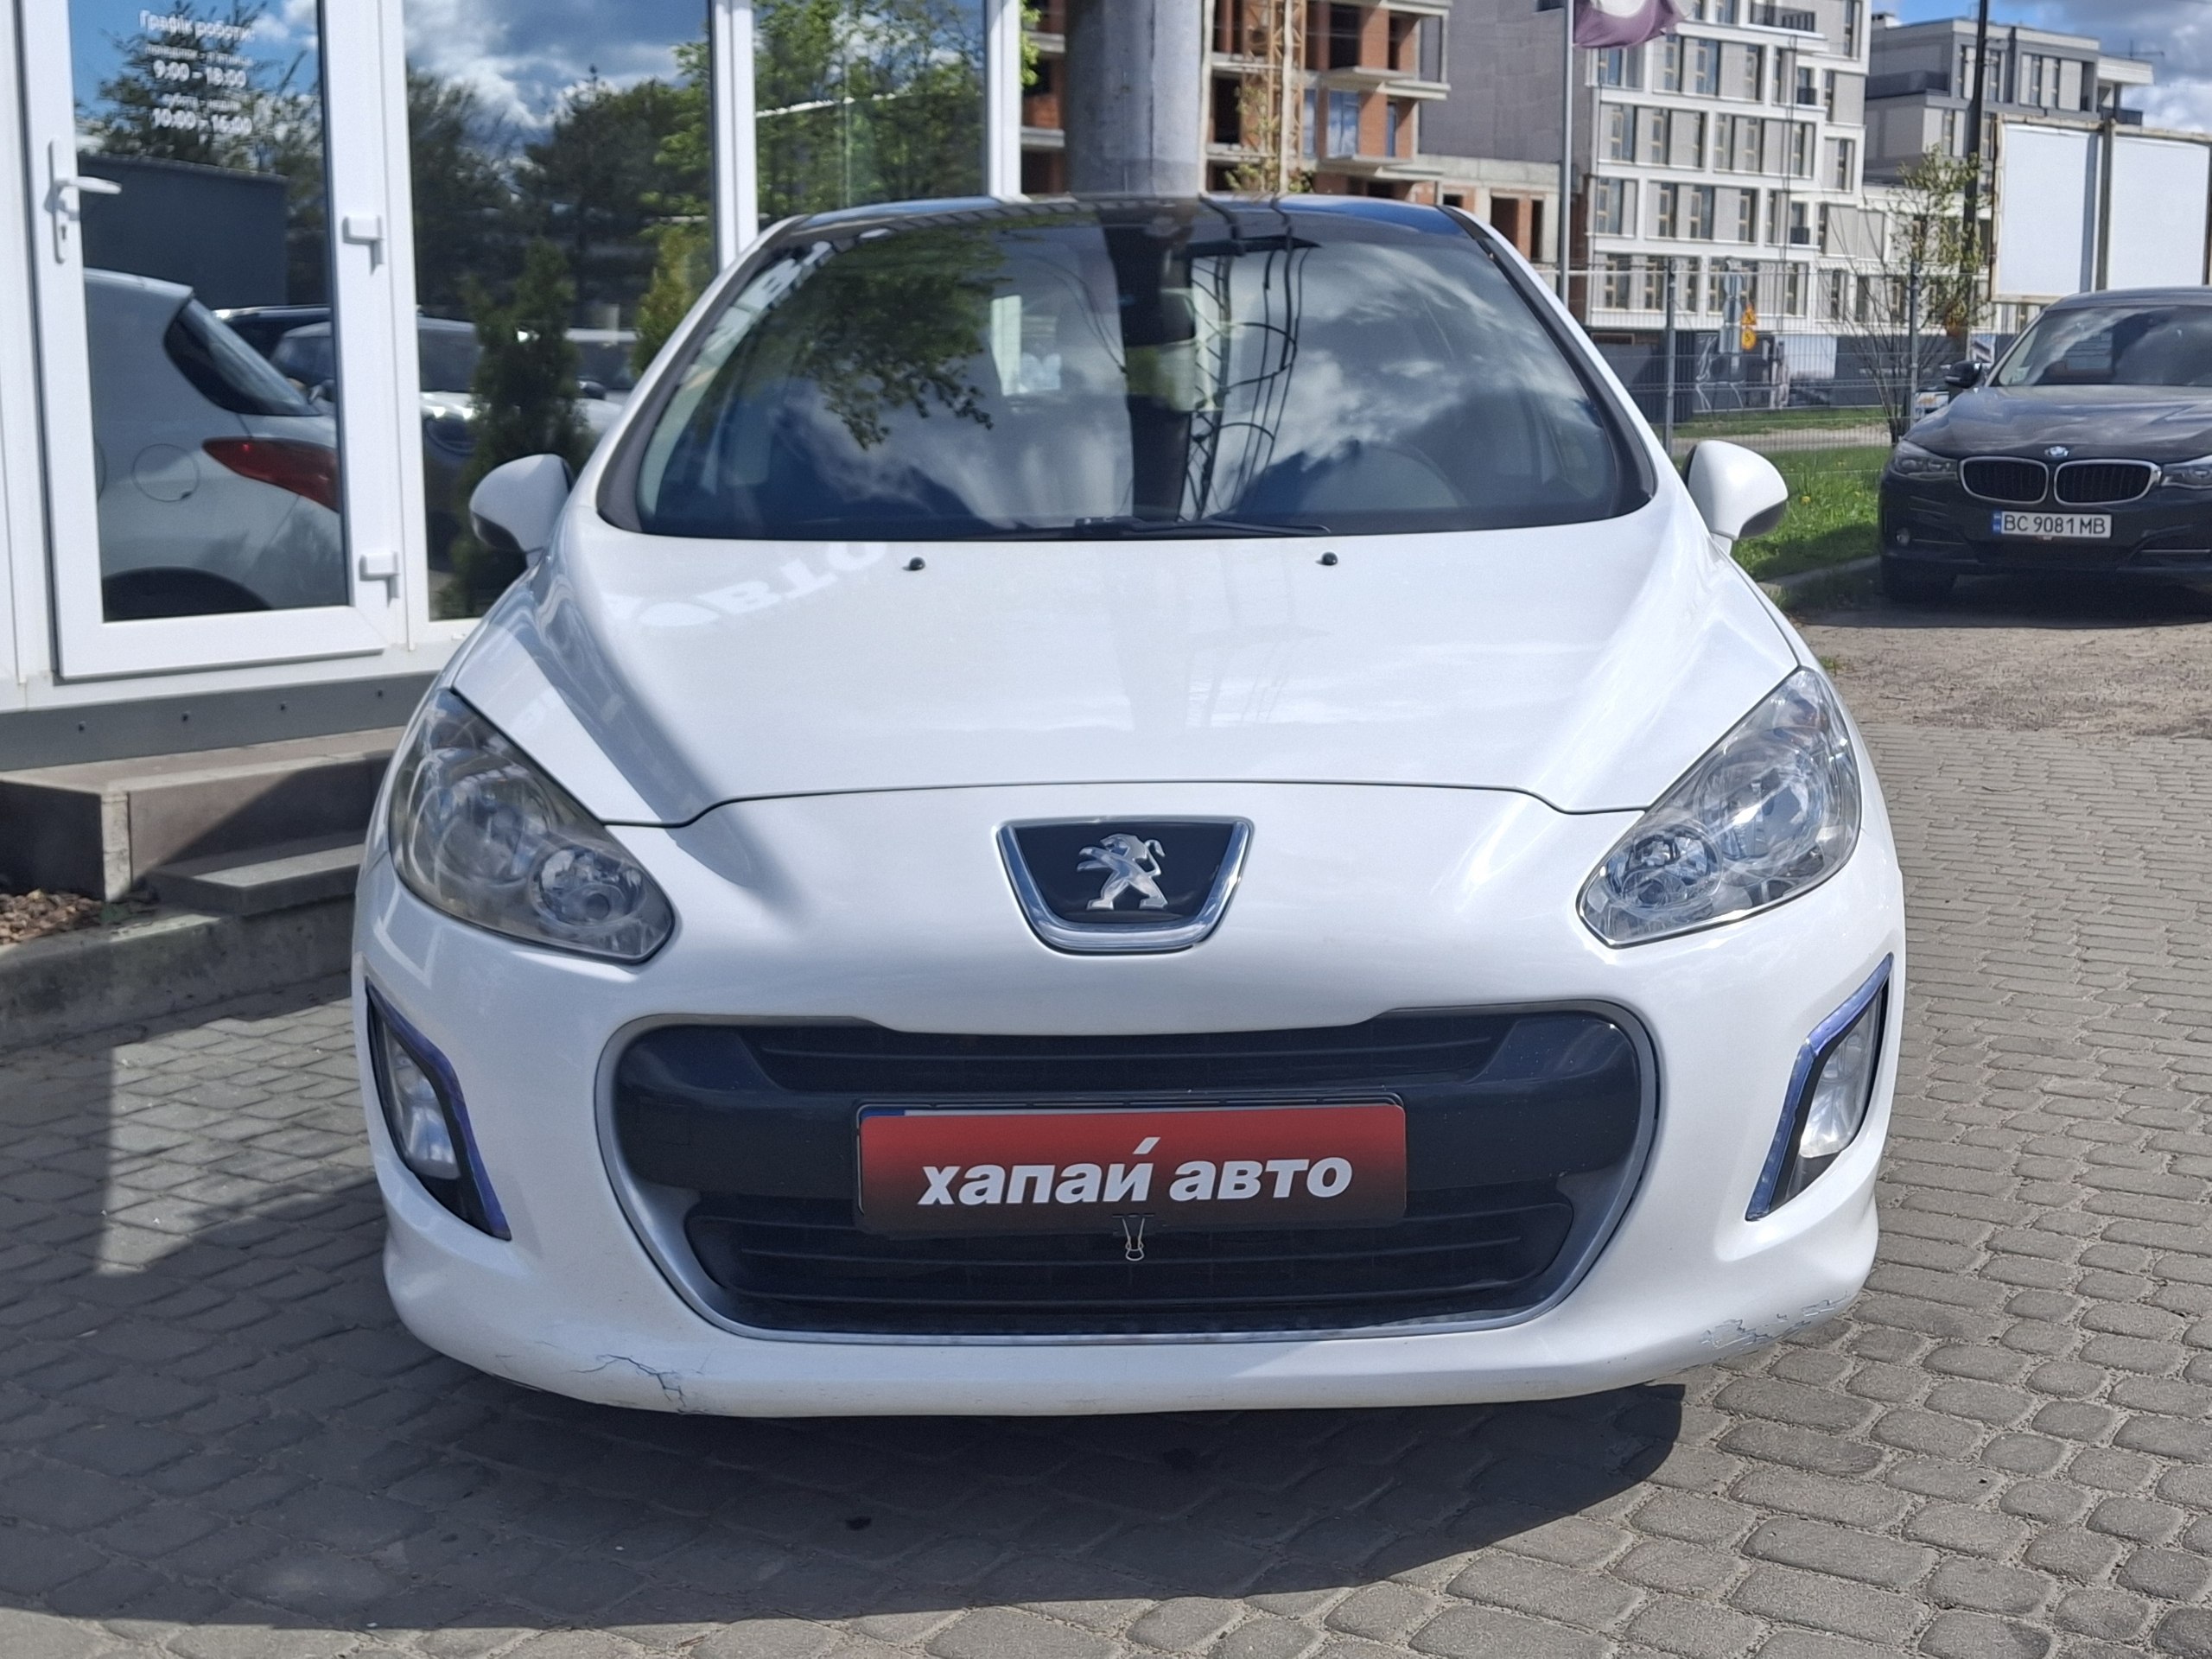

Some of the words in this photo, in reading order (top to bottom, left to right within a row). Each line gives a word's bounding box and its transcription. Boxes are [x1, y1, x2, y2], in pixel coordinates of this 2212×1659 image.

[153, 60, 190, 82] 9:00
[205, 67, 246, 88] 18:00
[152, 107, 196, 130] 10:00
[2004, 514, 2029, 531] BC
[2033, 516, 2075, 534] 9081
[2079, 517, 2106, 535] MB
[1168, 1156, 1353, 1201] авто
